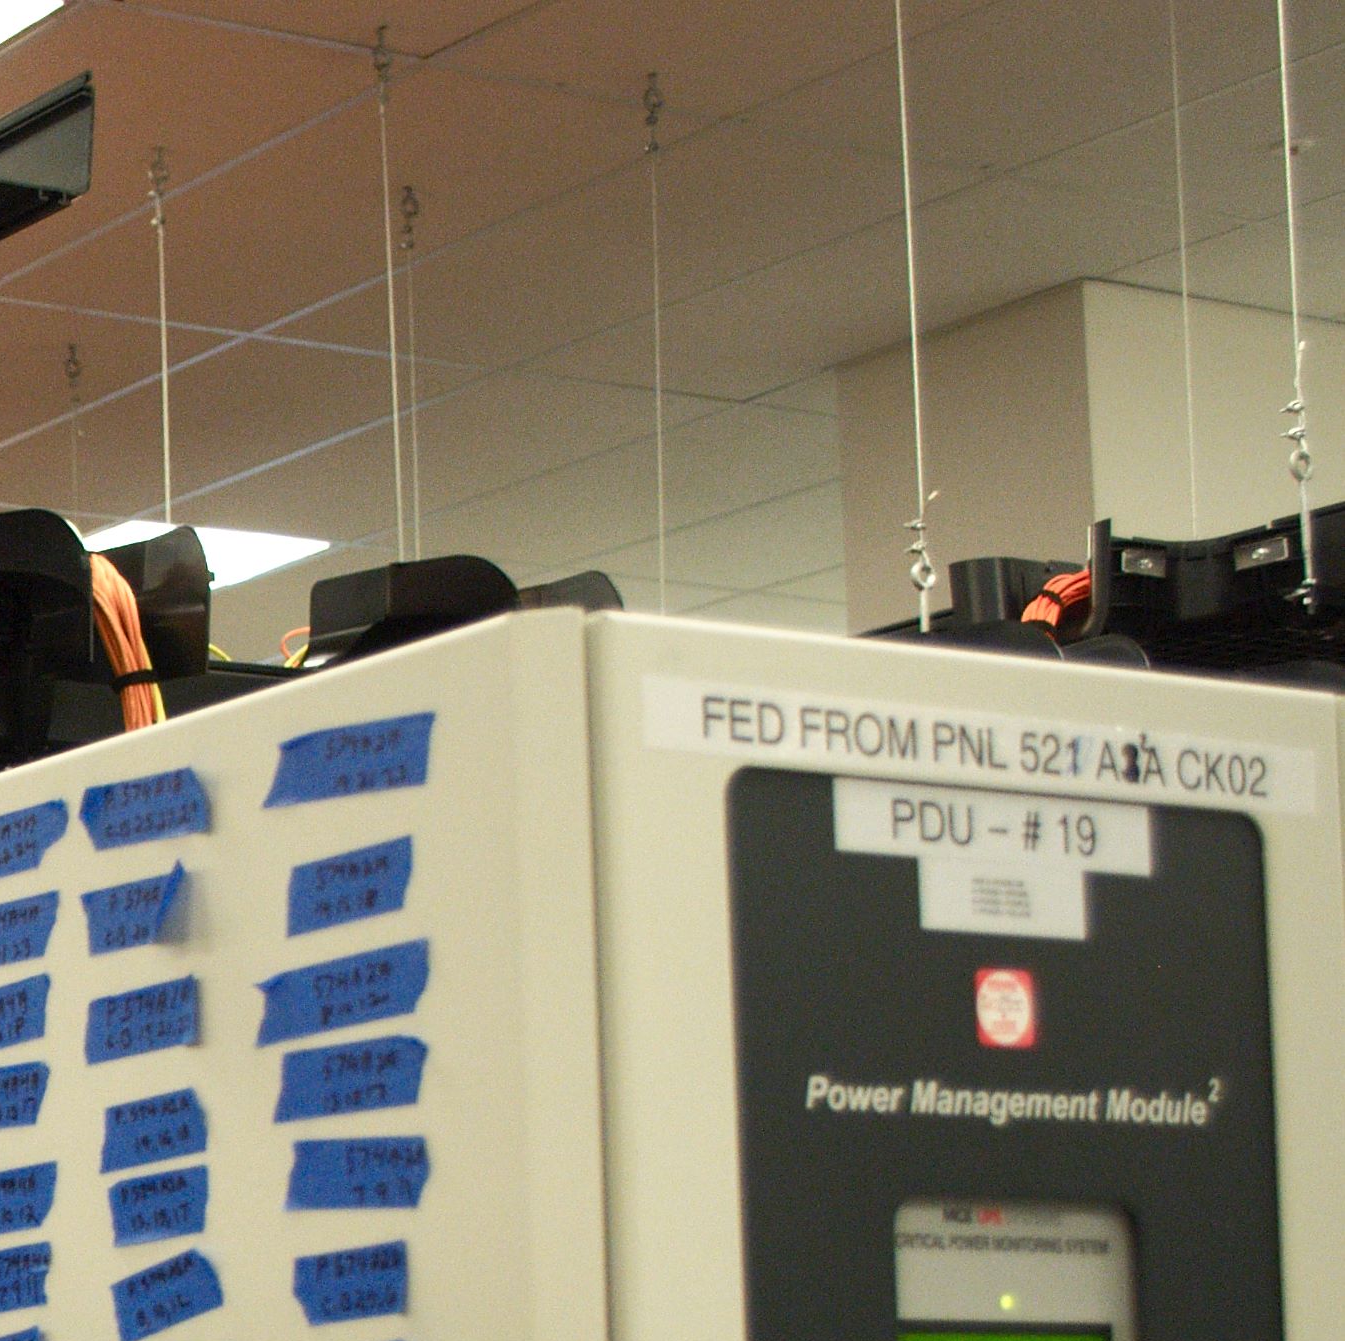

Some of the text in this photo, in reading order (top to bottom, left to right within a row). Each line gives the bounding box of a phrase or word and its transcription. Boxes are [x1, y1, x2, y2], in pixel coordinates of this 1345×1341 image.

[702, 696, 785, 746] FED
[798, 706, 918, 759] FROM
[932, 721, 1009, 770] PNL
[1020, 732, 1083, 776] 521
[1177, 749, 1268, 797] CK02
[892, 798, 973, 845] PDU
[1057, 814, 1096, 856] 19
[806, 1075, 904, 1112] Power
[910, 1079, 1097, 1126] Management
